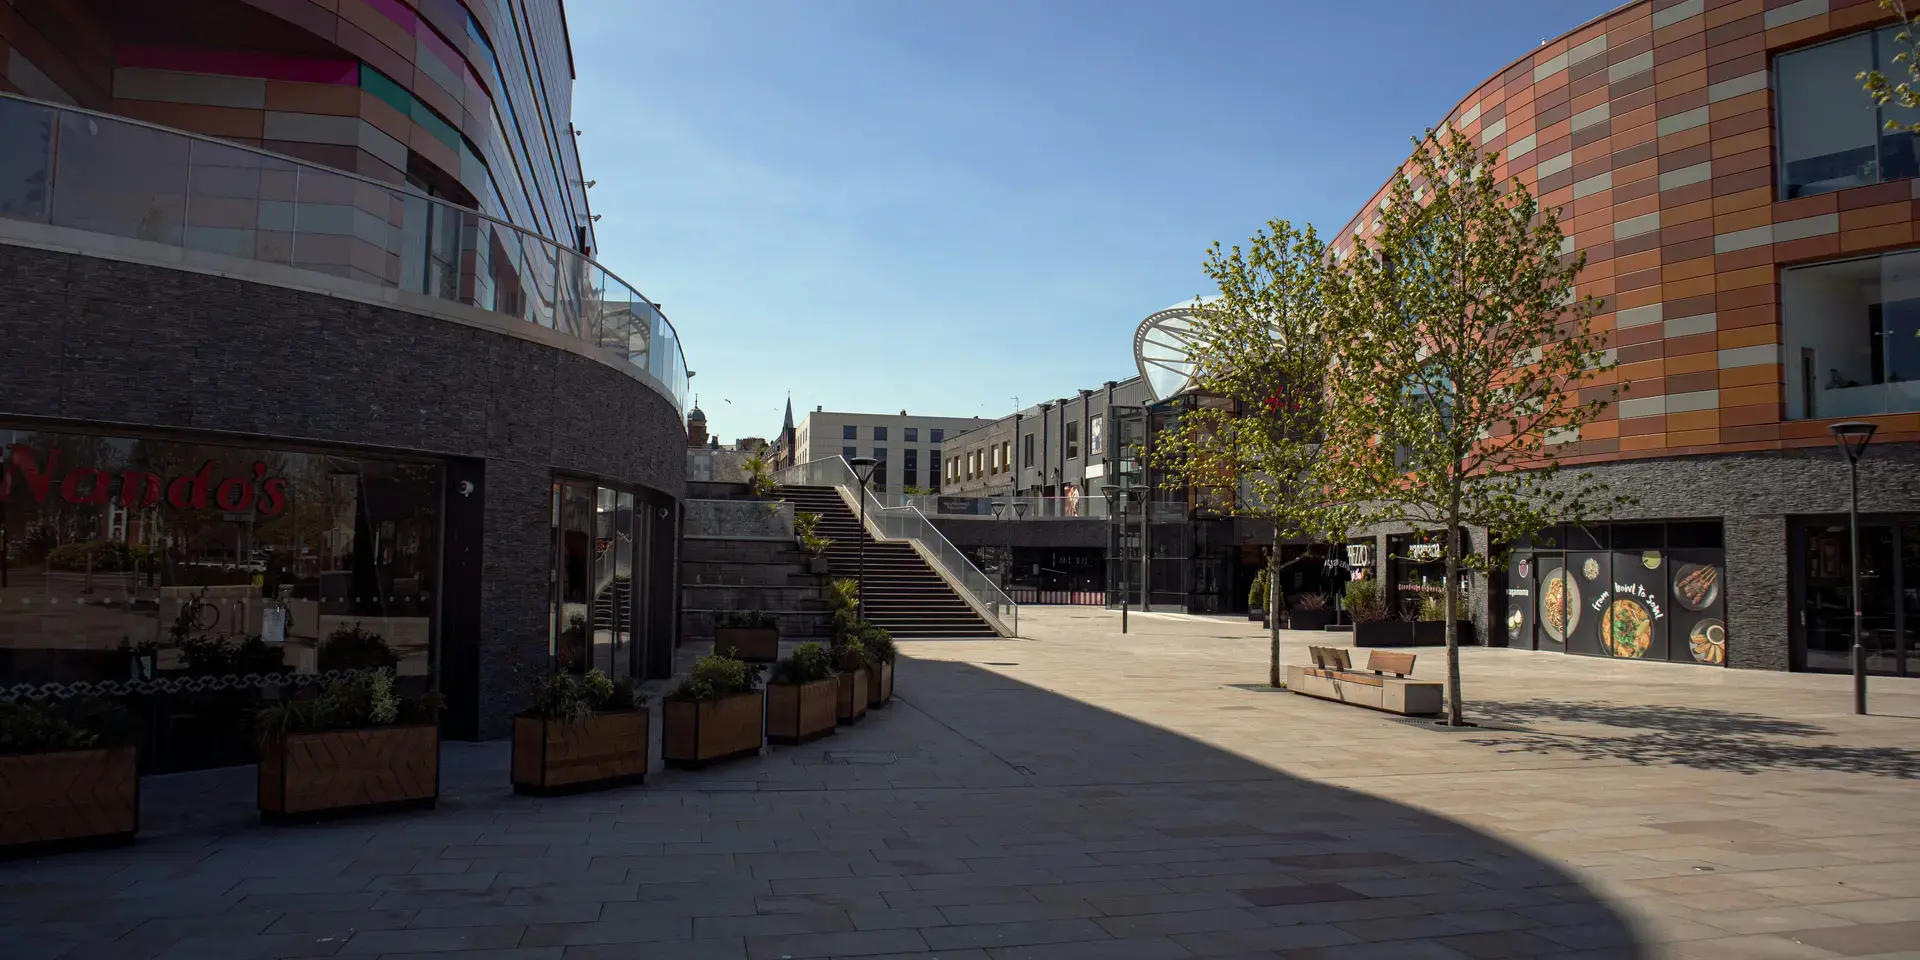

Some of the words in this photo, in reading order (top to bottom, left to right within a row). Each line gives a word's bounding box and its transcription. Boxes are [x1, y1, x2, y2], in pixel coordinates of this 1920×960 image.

[0, 444, 287, 515] Nando's
[1591, 590, 1610, 611] from
[1614, 581, 1636, 595] bowl
[1637, 583, 1646, 598] to
